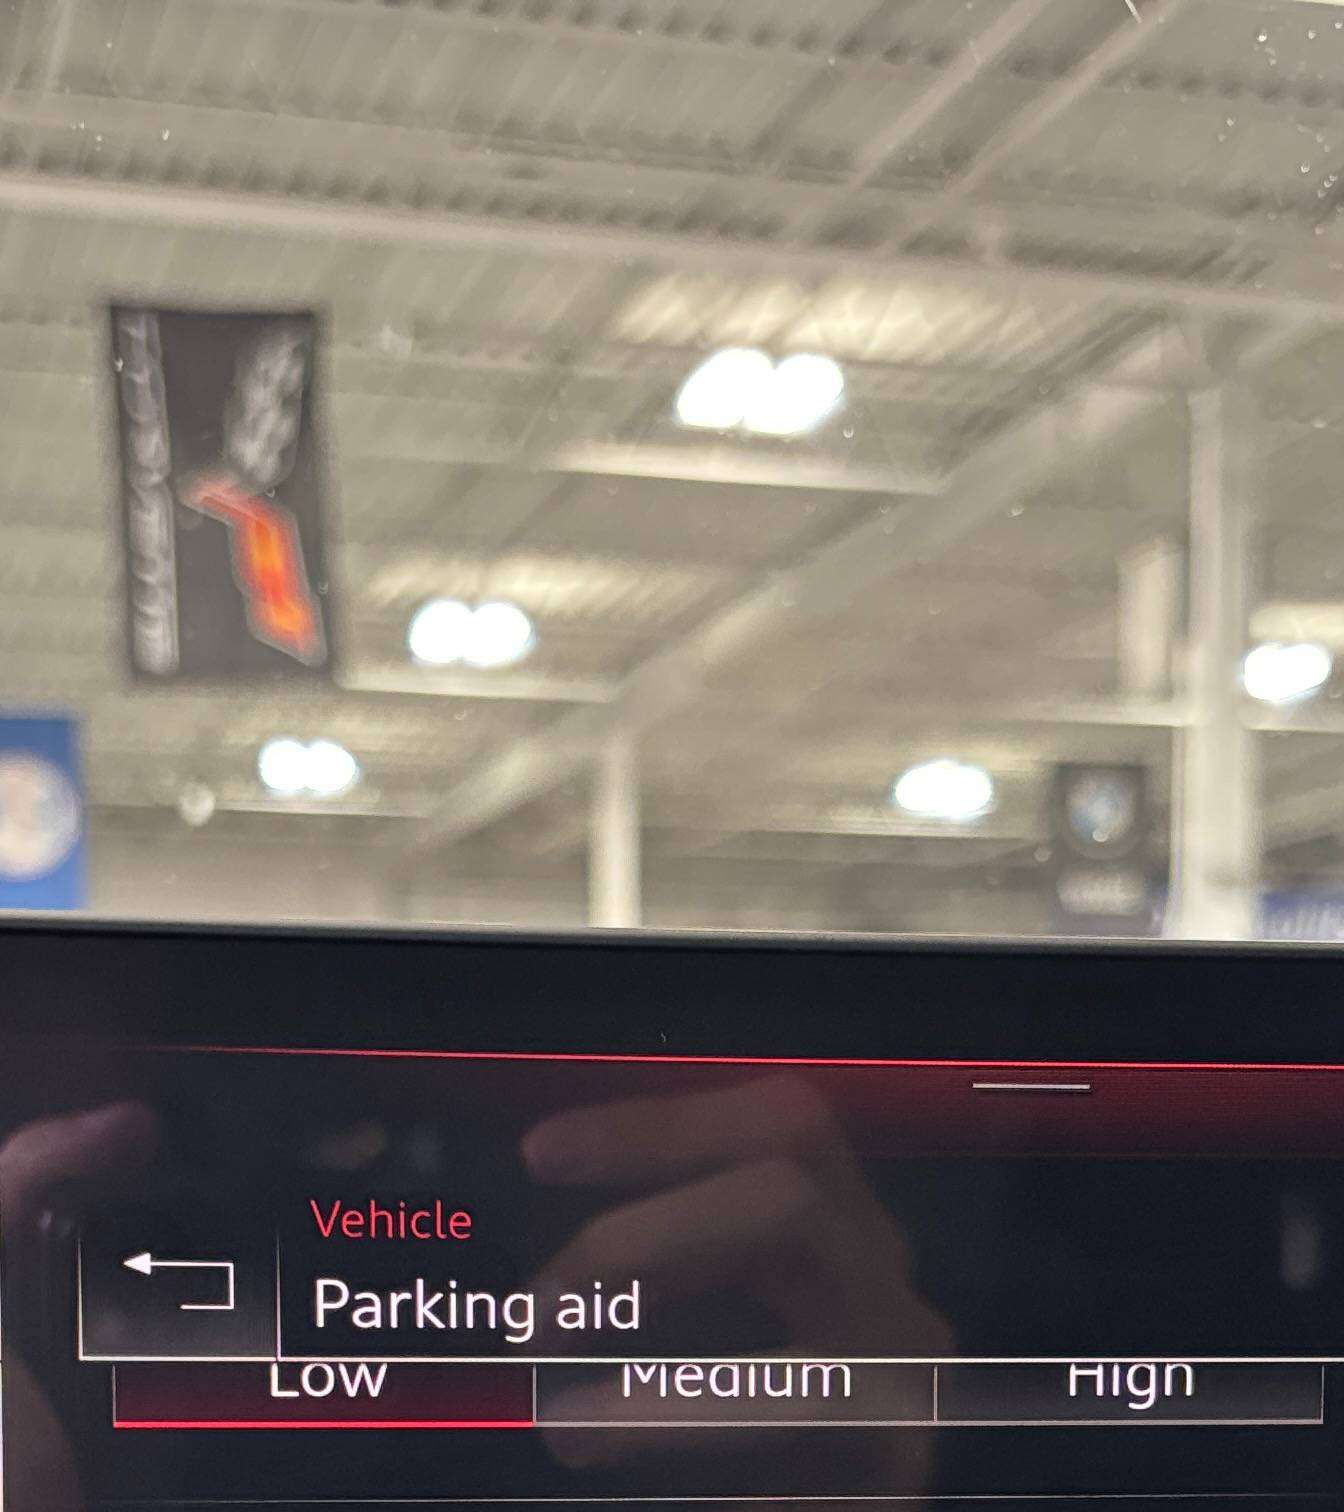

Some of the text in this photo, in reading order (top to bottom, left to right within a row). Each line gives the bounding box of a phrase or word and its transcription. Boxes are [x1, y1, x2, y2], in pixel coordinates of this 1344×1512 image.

[310, 1199, 472, 1240] Vehicle
[315, 1278, 641, 1344] Parking aid
[270, 1361, 1194, 1410] Low Medium High
